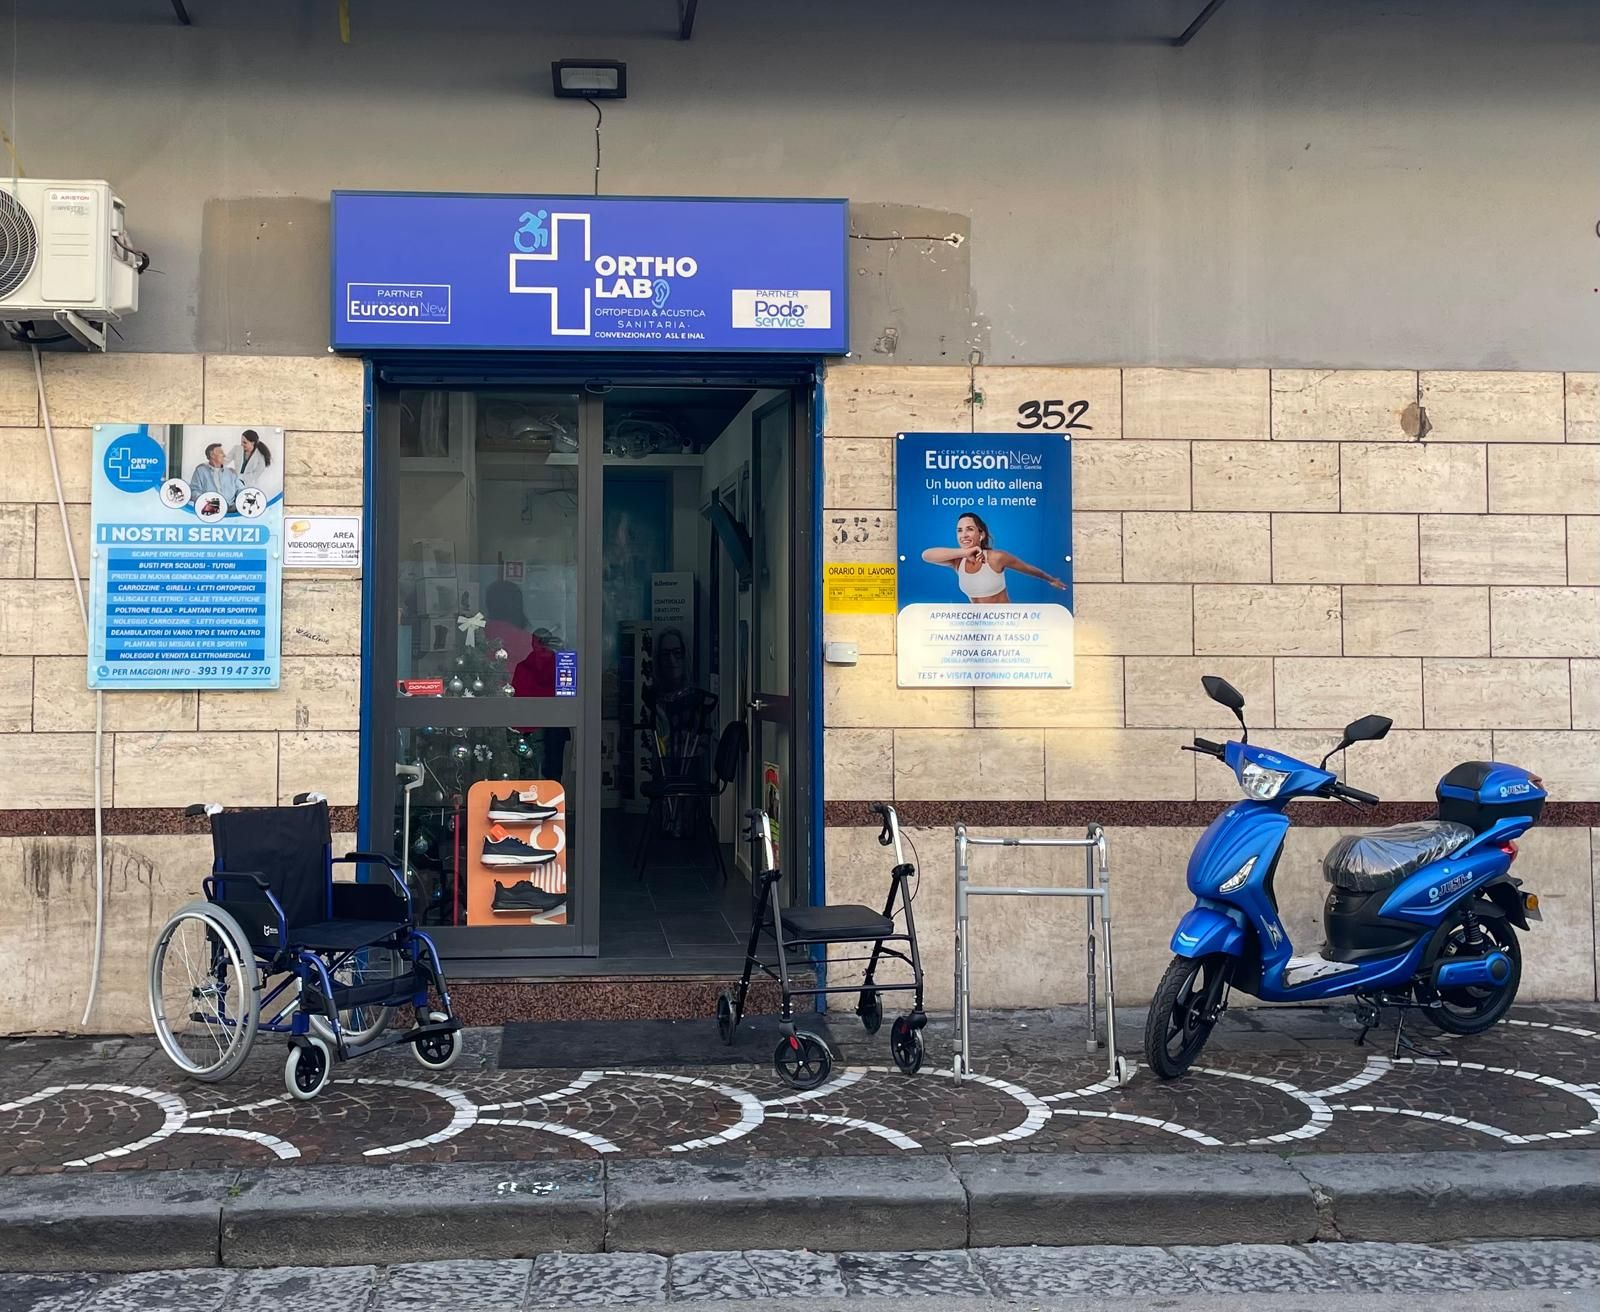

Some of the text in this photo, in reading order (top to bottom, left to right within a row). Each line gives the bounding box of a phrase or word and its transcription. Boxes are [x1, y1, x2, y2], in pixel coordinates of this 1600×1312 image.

[594, 256, 698, 278] ORTHO
[377, 289, 423, 299] PARTNER
[595, 278, 653, 299] LAB
[756, 290, 799, 298] PARTNER
[351, 300, 447, 317] Euroson New
[594, 308, 706, 318] ORTOPEDIA & ACUSTICA
[618, 320, 685, 329] SANITARIA
[755, 317, 805, 328] service
[1016, 400, 1093, 430] 352
[926, 450, 1042, 470] Euroson New
[926, 478, 1042, 490] Un buon udito allena
[932, 495, 1036, 508] il corpo e la mente
[102, 527, 260, 542] I NOSTRI SERVIZI
[198, 666, 217, 675] 393
[221, 666, 233, 675] 19
[236, 666, 249, 675] 47
[251, 666, 271, 675] 370
